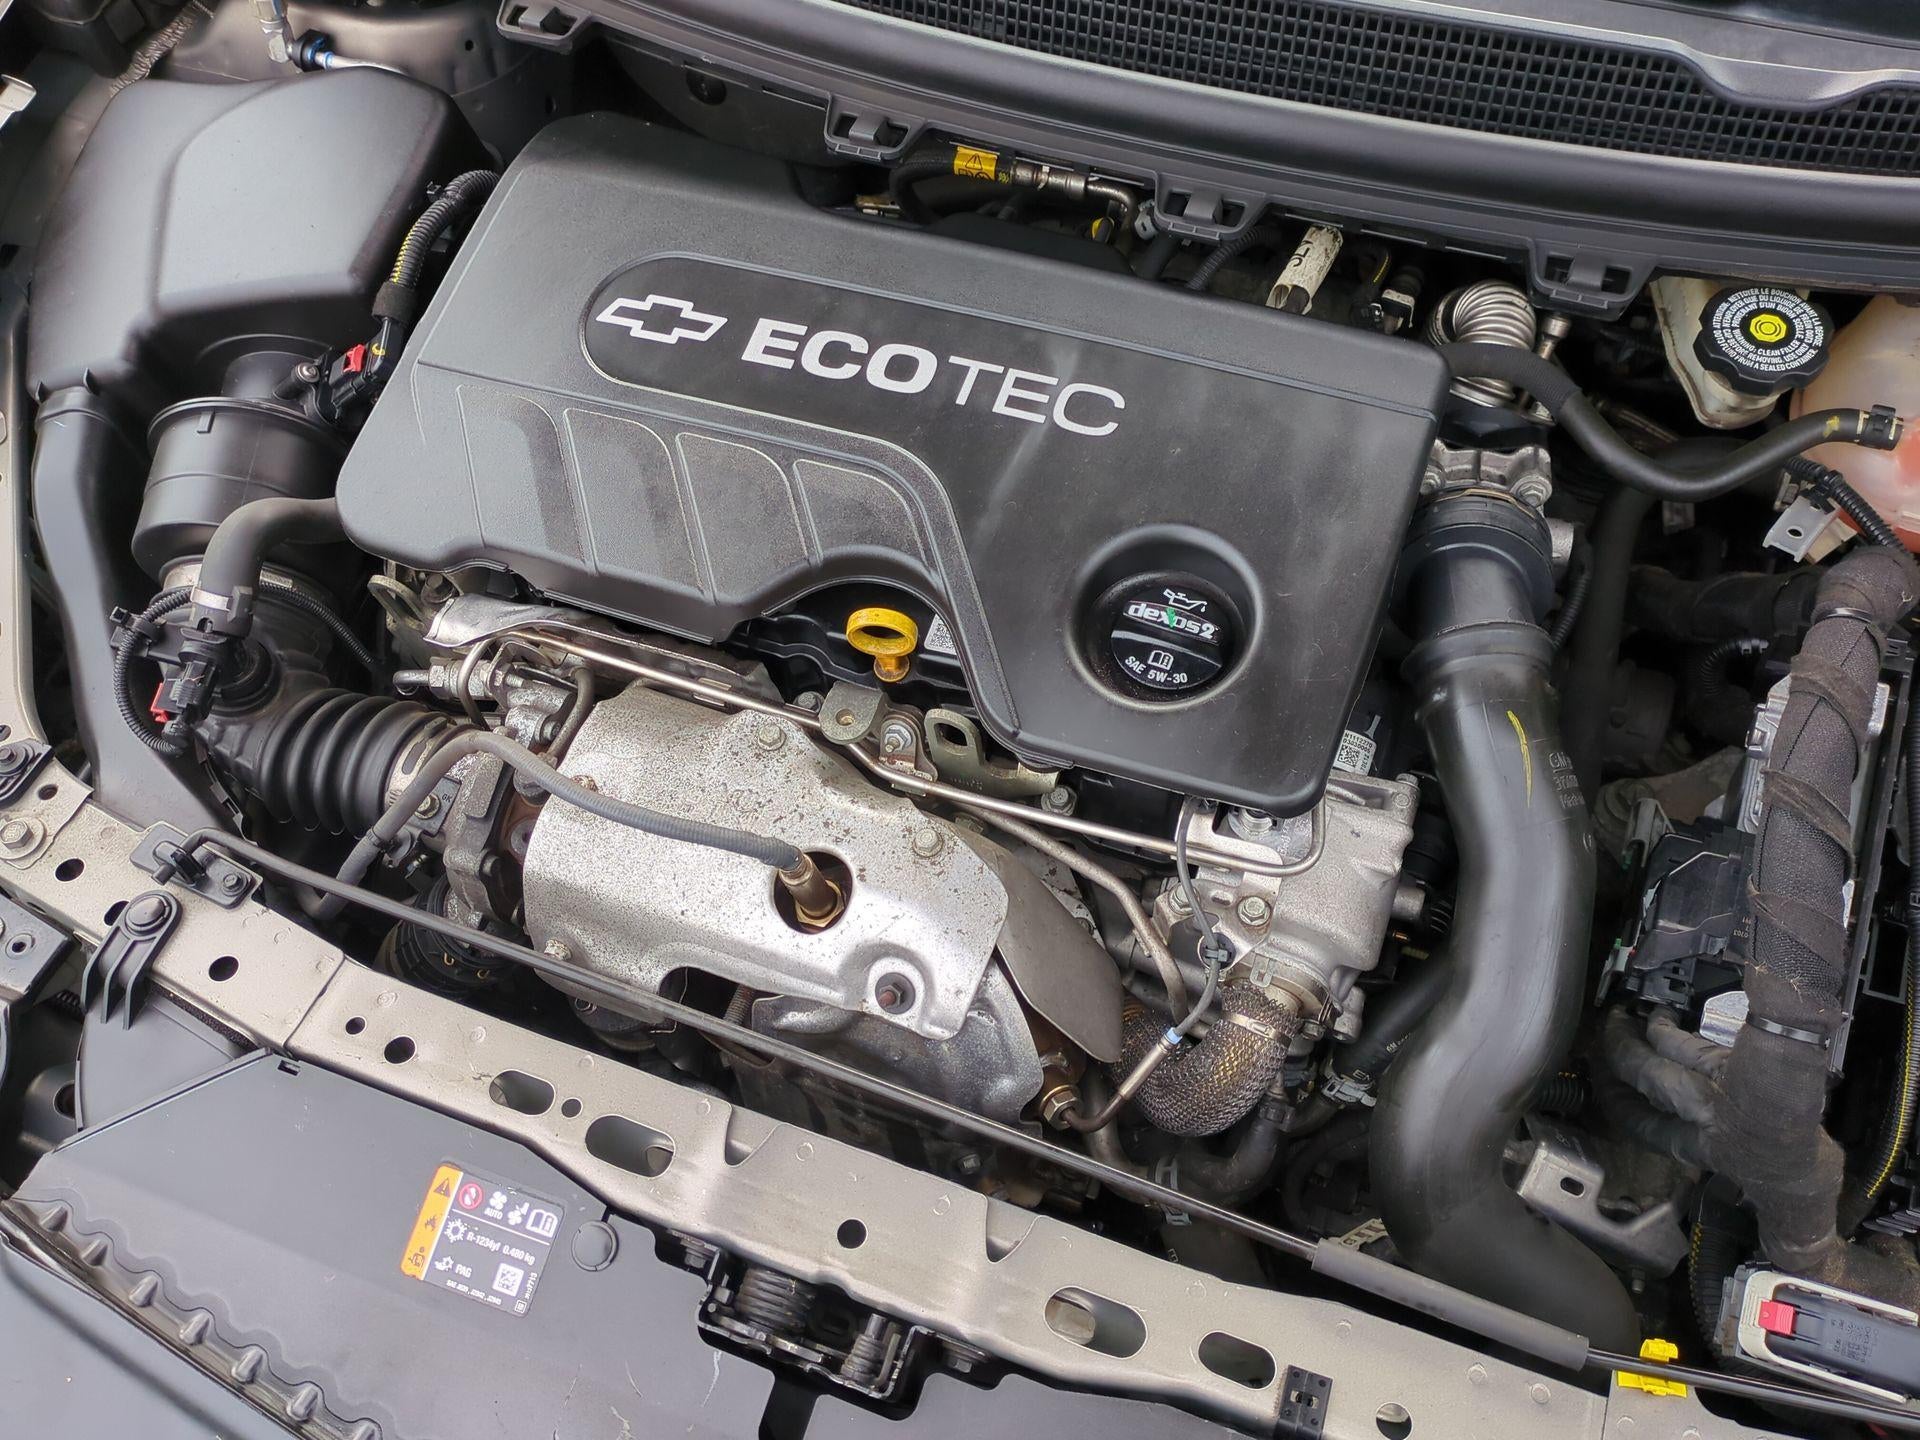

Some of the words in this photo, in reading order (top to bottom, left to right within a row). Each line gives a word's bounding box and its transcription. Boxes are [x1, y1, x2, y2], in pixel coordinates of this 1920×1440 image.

[1727, 288, 1760, 303] NETTOYER
[1770, 289, 1802, 305] BOUCHON
[1799, 302, 1818, 318] AVANT
[1812, 317, 1822, 326] LA
[1743, 295, 1758, 304] QUE
[1759, 294, 1768, 302] DU
[1770, 295, 1796, 309] LIQUIDE
[1793, 306, 1804, 315] DE
[1799, 313, 1814, 329] FREIN
[1759, 301, 1776, 309] D'UN
[1776, 304, 1797, 319] BIDON
[1722, 328, 1733, 339] CAP
[1732, 329, 1757, 353] WARNING:
[1757, 348, 1781, 356] CLEAN
[1780, 339, 1801, 355] FILLER
[1713, 329, 1726, 344] DOT3
[1720, 342, 1737, 358] FLUID
[1734, 355, 1754, 368] FROM
[1753, 362, 1759, 370] A
[1759, 363, 1786, 371] SEALED
[1785, 348, 1819, 370] CONTAINER.
[1727, 338, 1749, 356] BEFORE
[1783, 351, 1798, 362] USE
[1795, 342, 1809, 356] ONLY
[1747, 352, 1785, 364] REMOVING.
[741, 317, 1126, 437] ECOTEC
[1127, 602, 1216, 640] dexos2
[1125, 656, 1146, 675] SAE
[1147, 670, 1188, 684] 5W-30
[484, 1207, 503, 1220] AUTO
[502, 1244, 525, 1260] 0.480
[525, 1252, 536, 1266] kg
[455, 1262, 473, 1278] PAG
